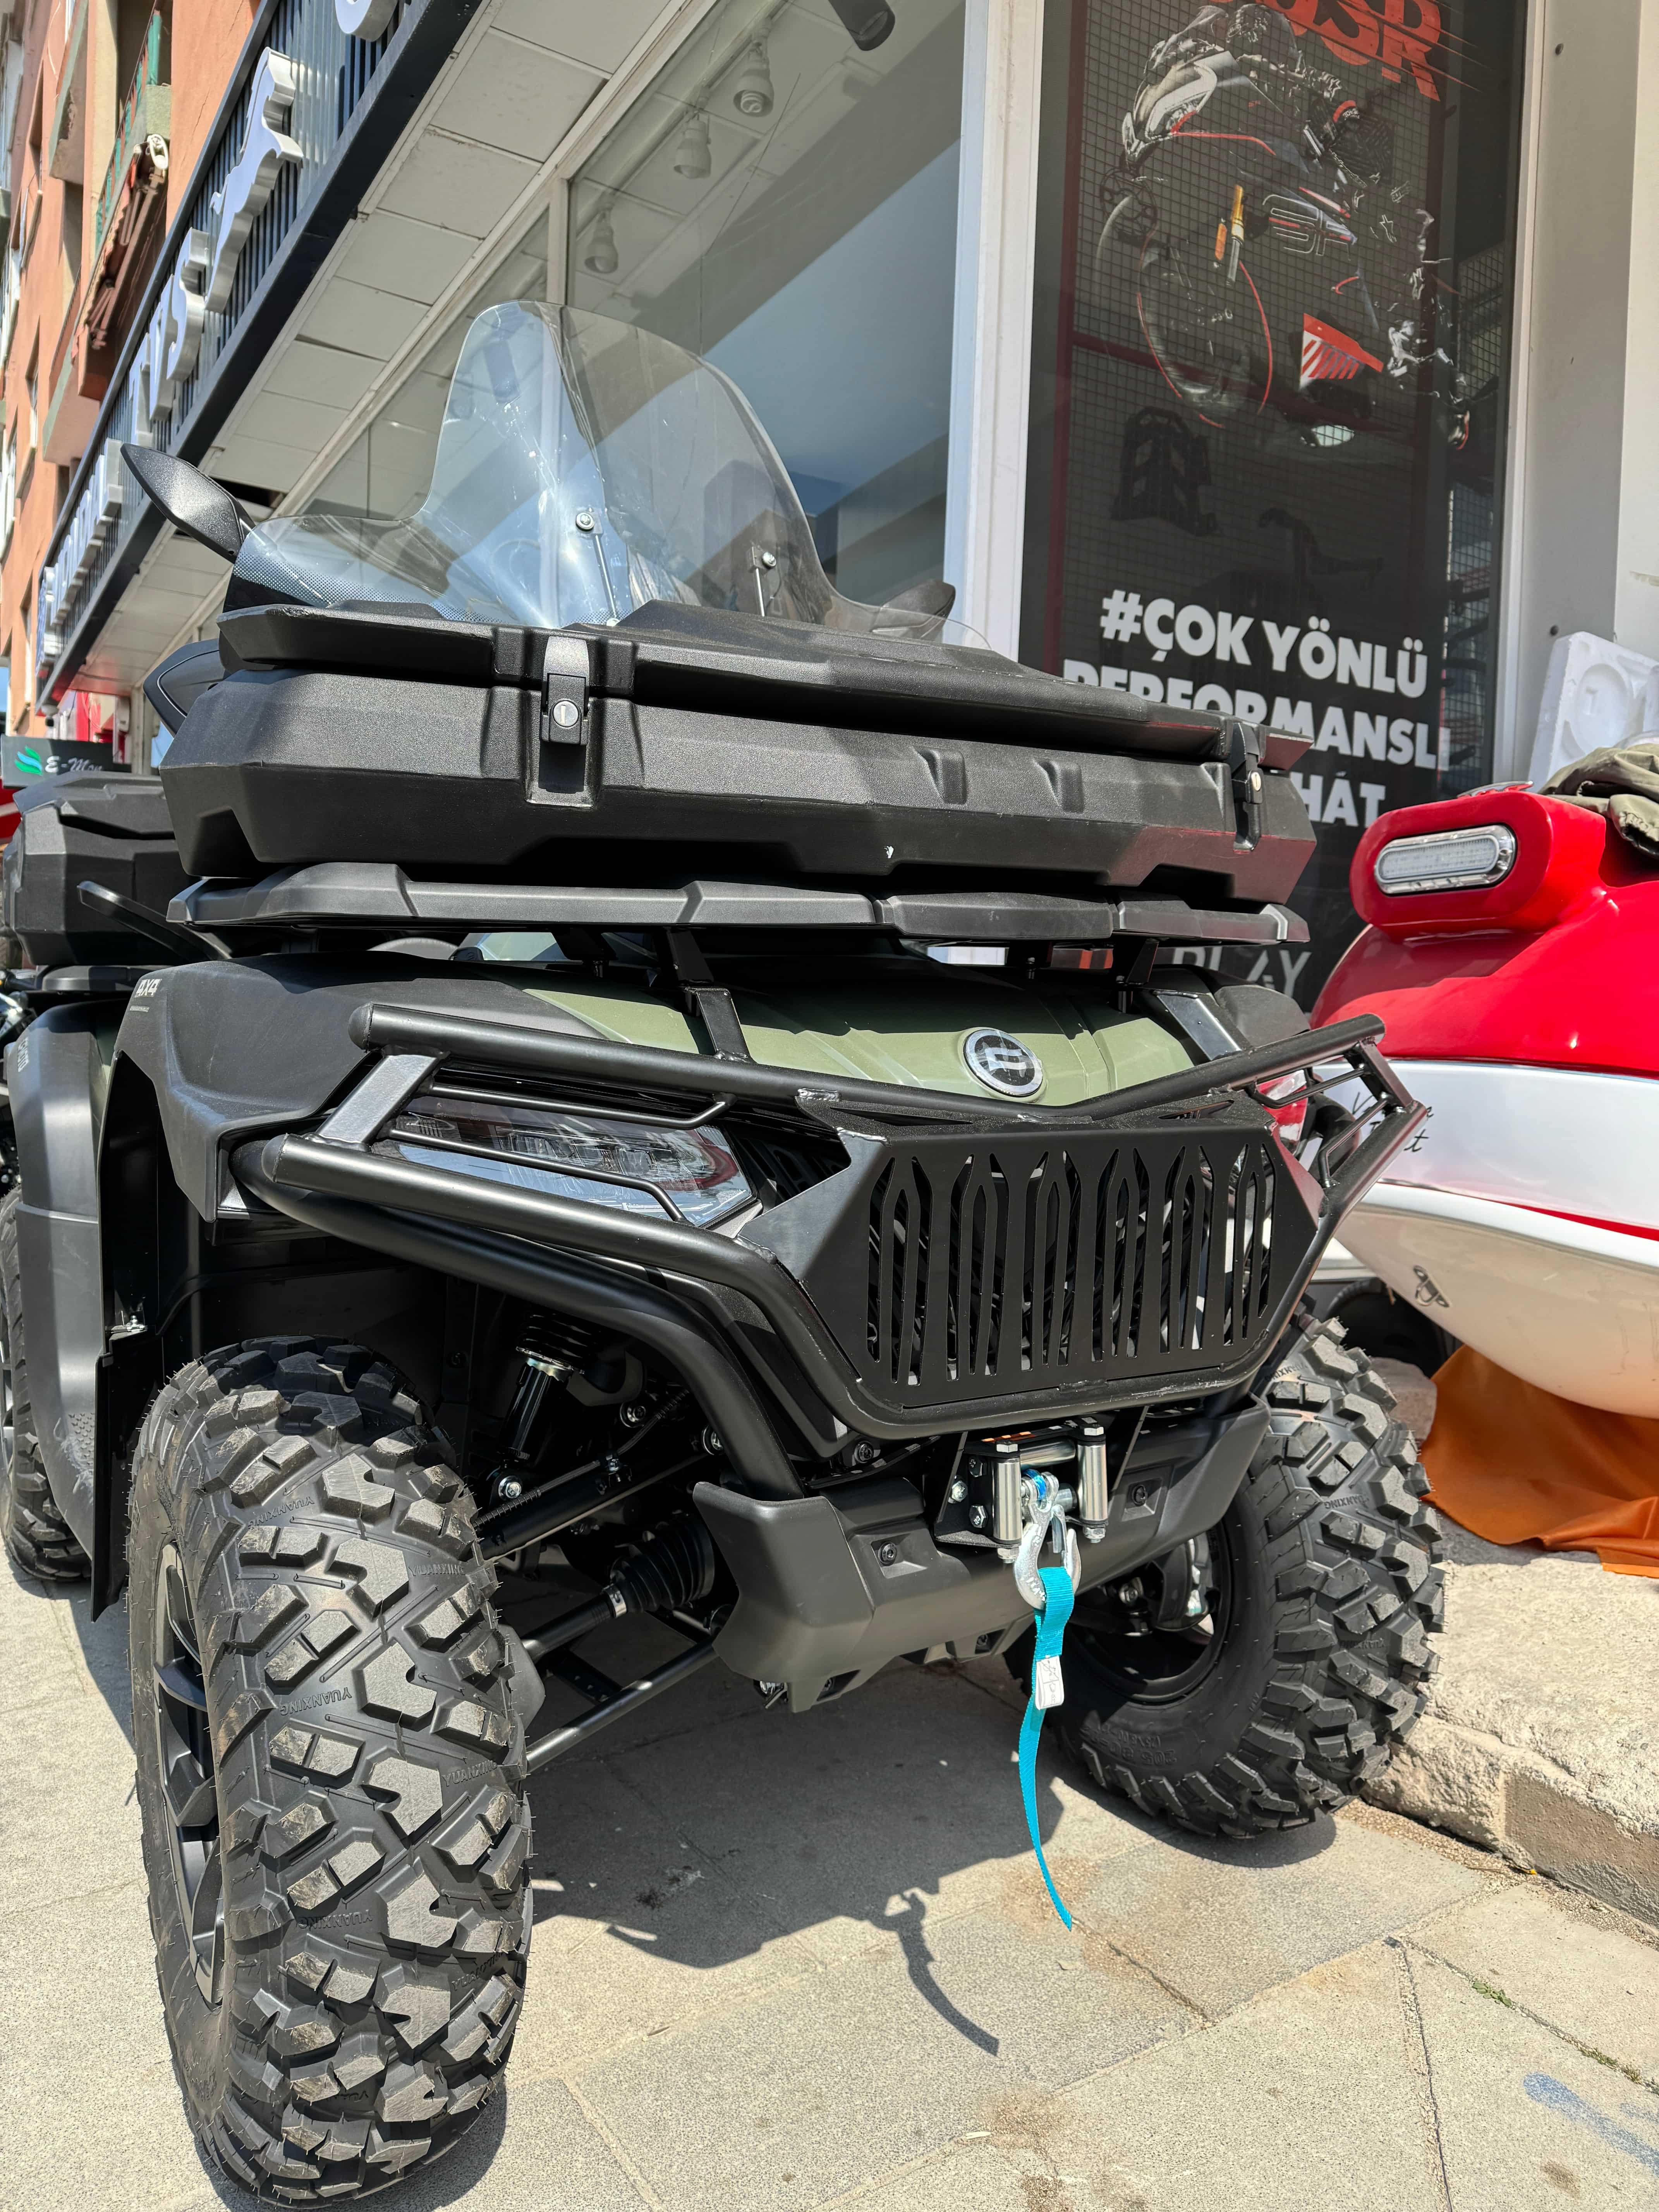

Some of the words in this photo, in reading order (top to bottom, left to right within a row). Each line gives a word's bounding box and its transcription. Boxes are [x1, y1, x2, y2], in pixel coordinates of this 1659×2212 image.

[129, 227, 210, 448] TVS
[1100, 589, 1254, 666] #ÇOK
[1262, 615, 1428, 698] YÖNLÜ
[248, 1496, 315, 1530] YUANXING
[279, 1687, 353, 1716] YUANXING
[442, 1759, 498, 1787] YUANXING
[297, 1909, 373, 1929] YUANXING
